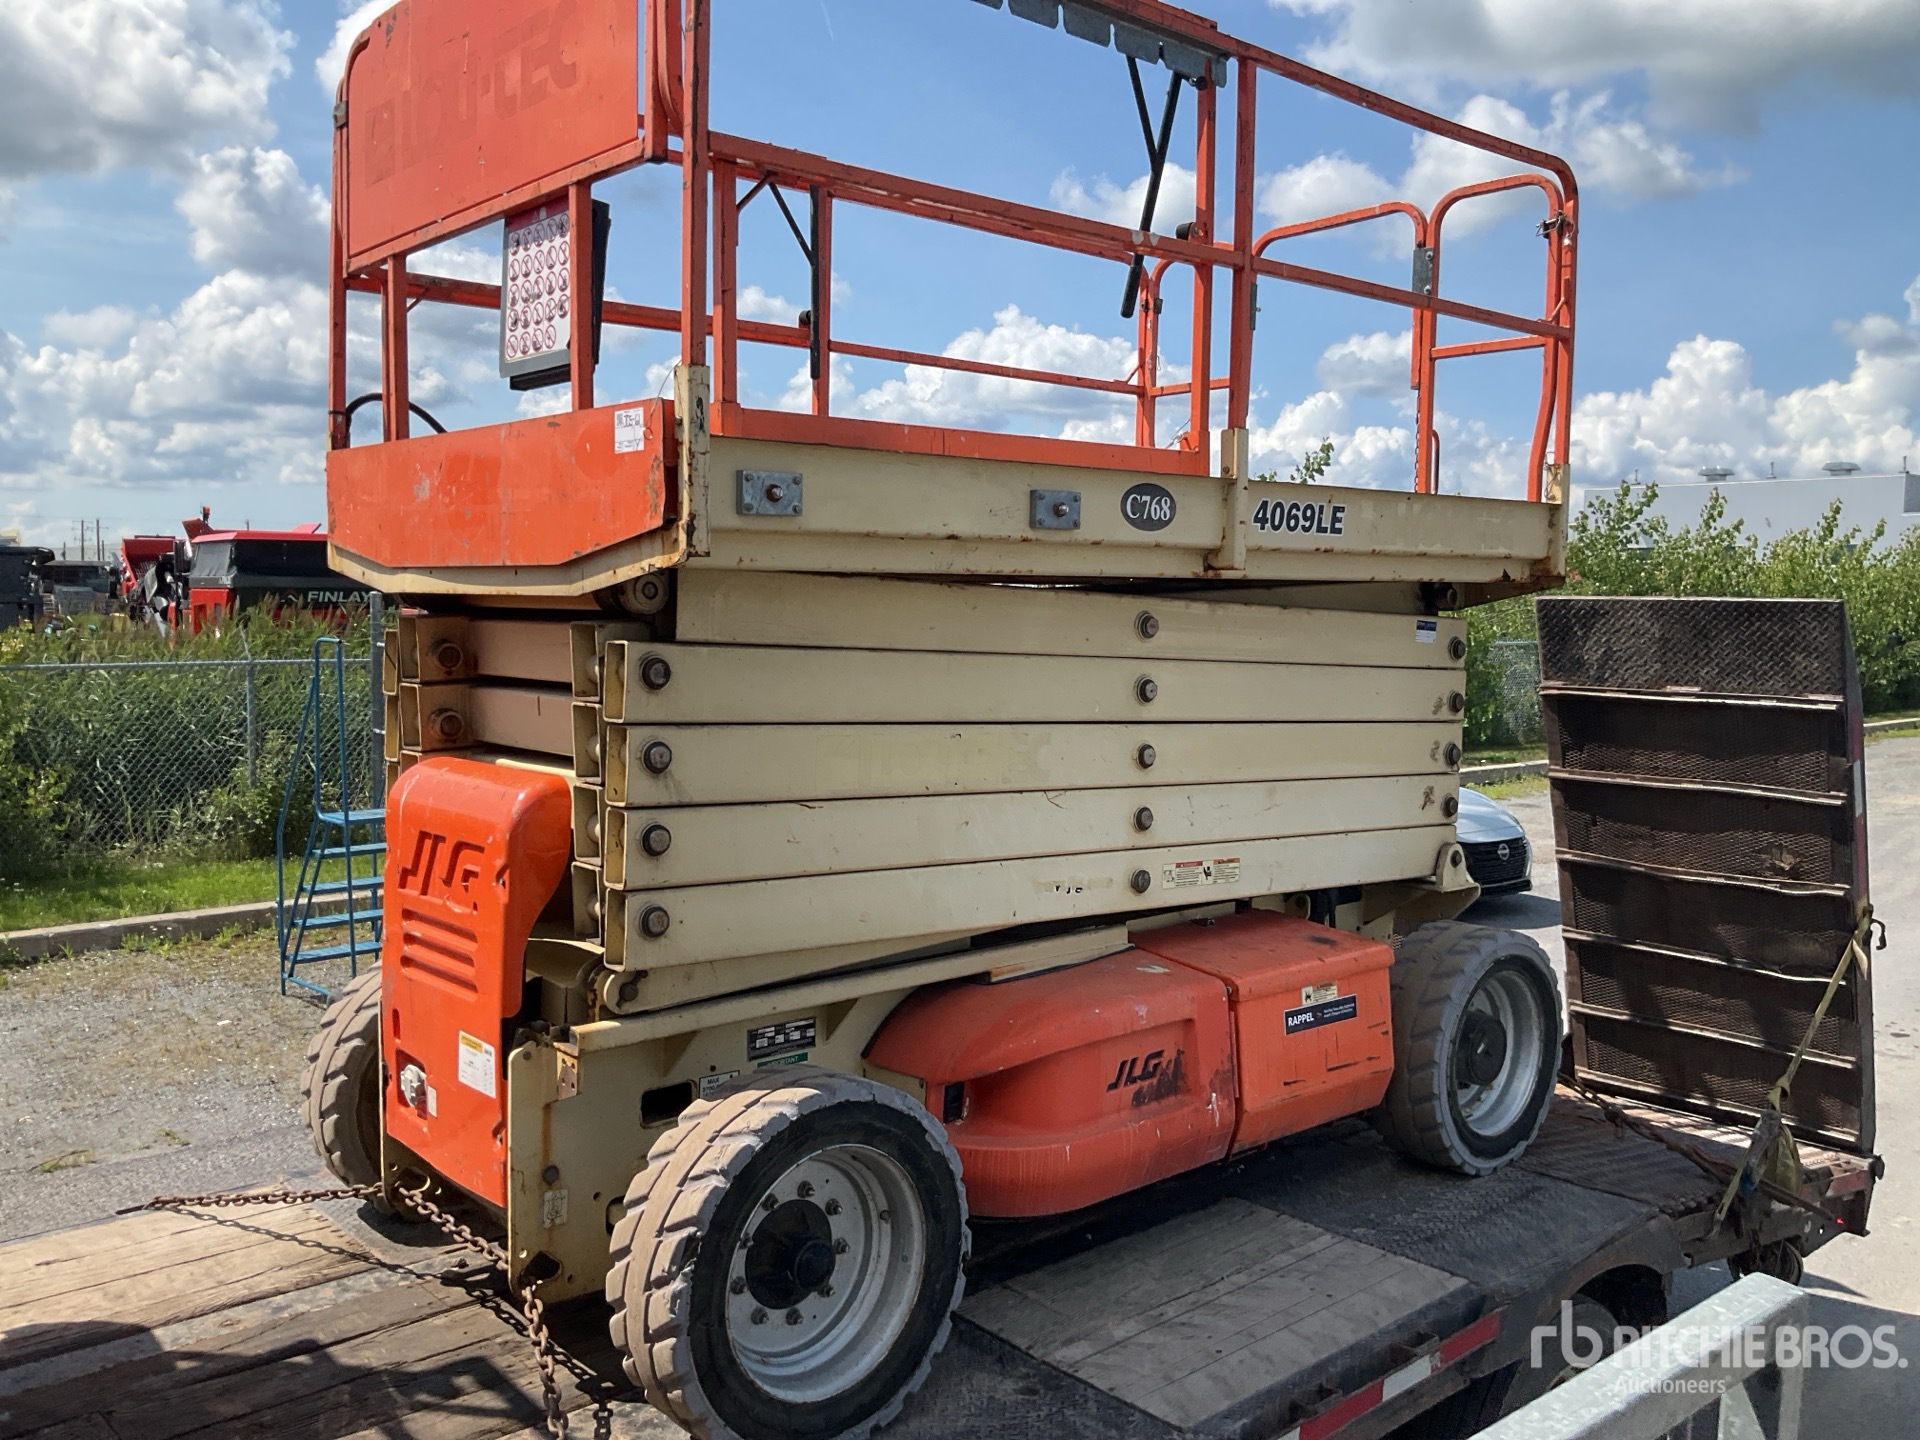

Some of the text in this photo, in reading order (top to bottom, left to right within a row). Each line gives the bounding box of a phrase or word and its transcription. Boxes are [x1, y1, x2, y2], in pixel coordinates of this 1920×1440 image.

[1126, 493, 1171, 521] C768
[1253, 498, 1347, 537] 4069LE
[307, 591, 371, 603] FINLAY
[1287, 1011, 1315, 1027] RAPPEL
[707, 1077, 720, 1085] MAX
[1106, 1049, 1165, 1092] JLG
